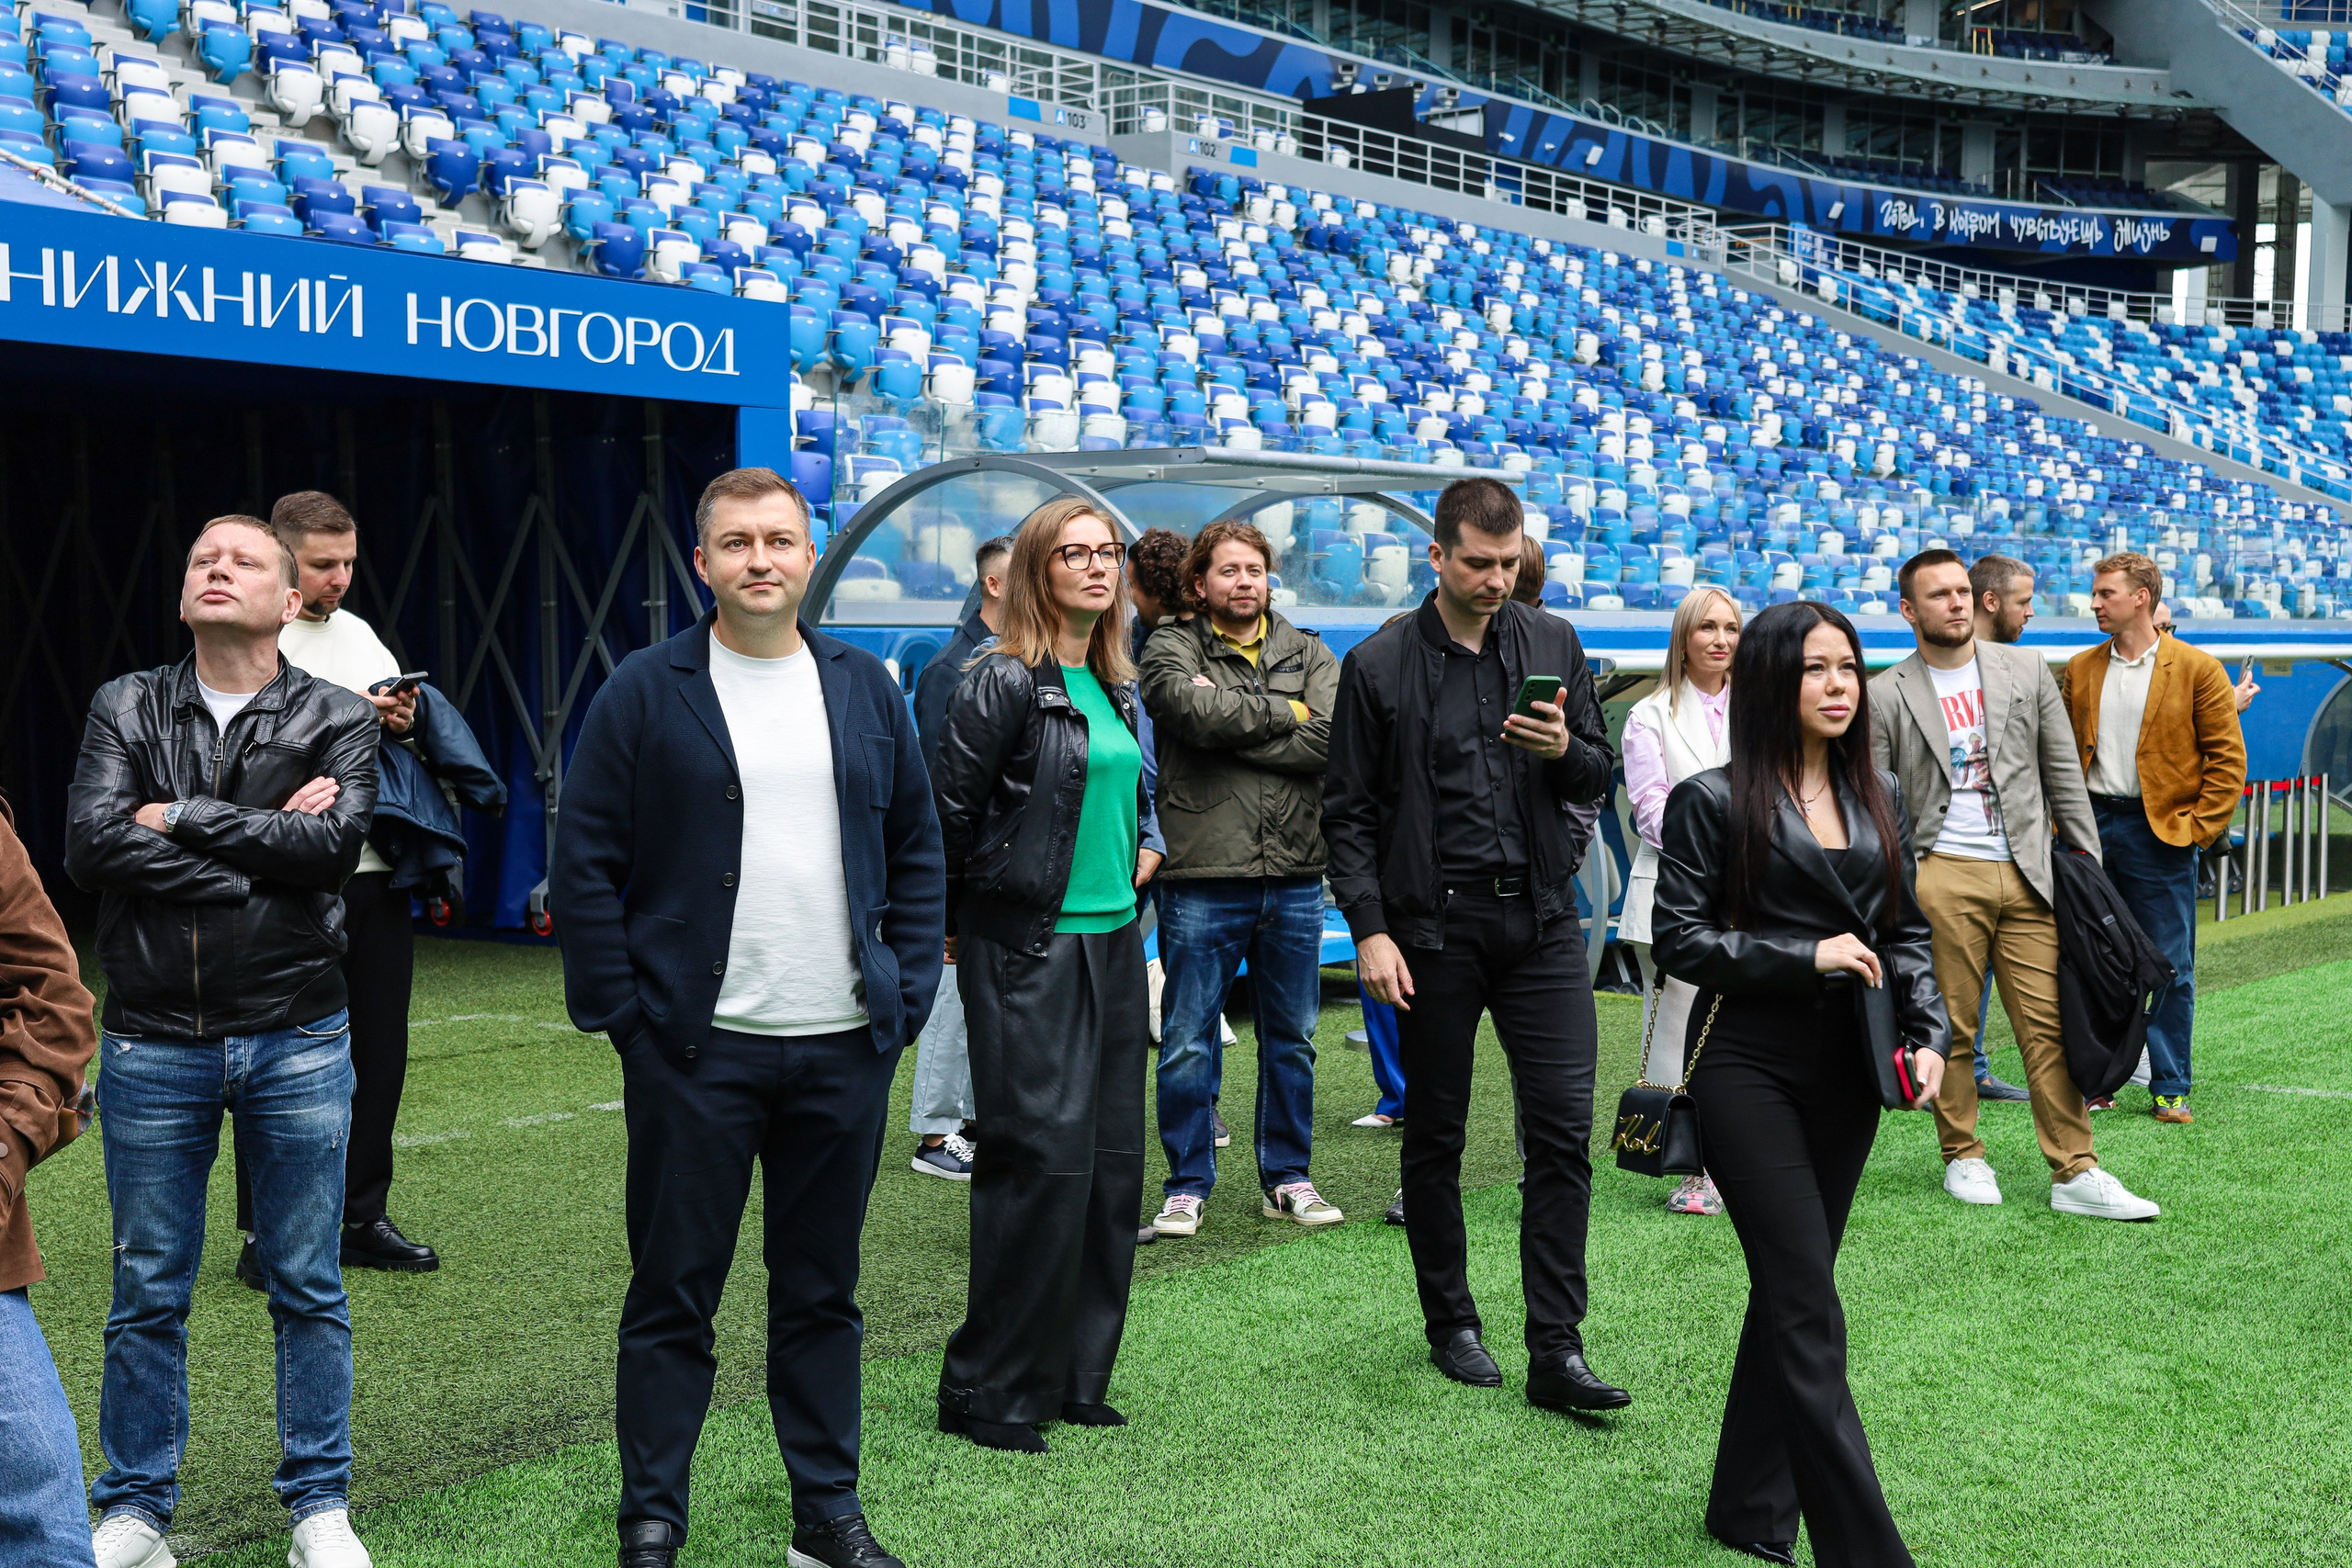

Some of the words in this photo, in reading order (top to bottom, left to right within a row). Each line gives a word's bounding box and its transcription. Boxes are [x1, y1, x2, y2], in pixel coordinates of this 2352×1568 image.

[1068, 112, 1086, 129] 103
[1200, 141, 1216, 157] 102
[0, 243, 364, 338] НИЖНИЙ
[406, 292, 741, 376] НОВГОРОД
